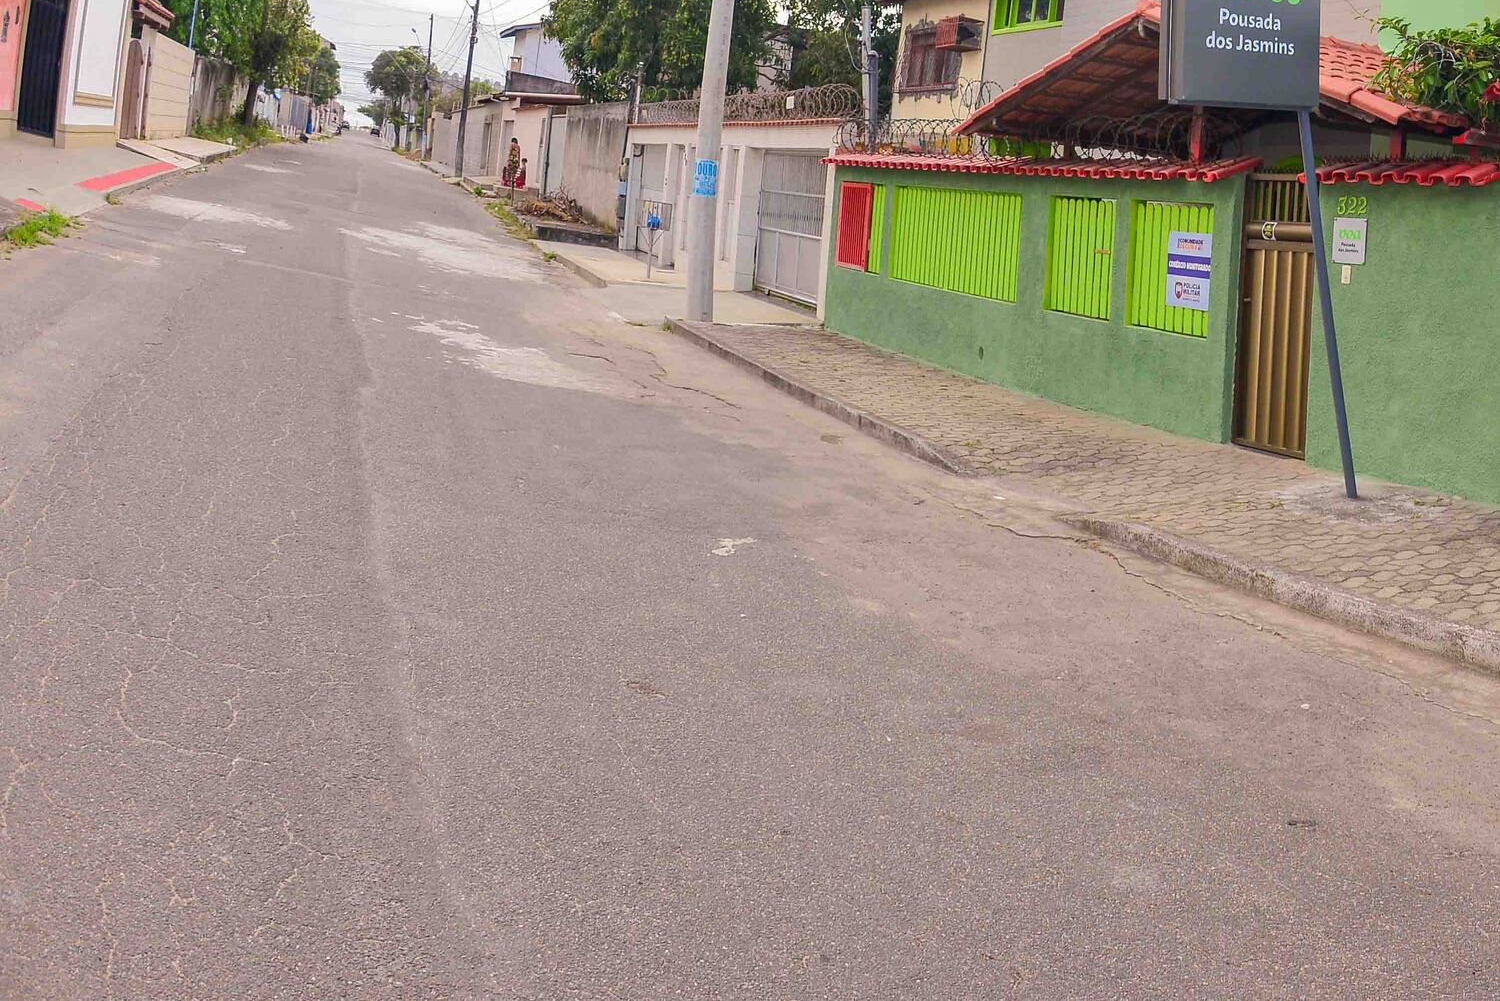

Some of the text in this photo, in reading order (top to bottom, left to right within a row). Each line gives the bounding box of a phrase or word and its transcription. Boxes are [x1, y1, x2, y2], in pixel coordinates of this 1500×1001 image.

[1219, 7, 1281, 31] Pousada
[1205, 30, 1295, 55] dos Jasmins
[1338, 195, 1367, 215] 322
